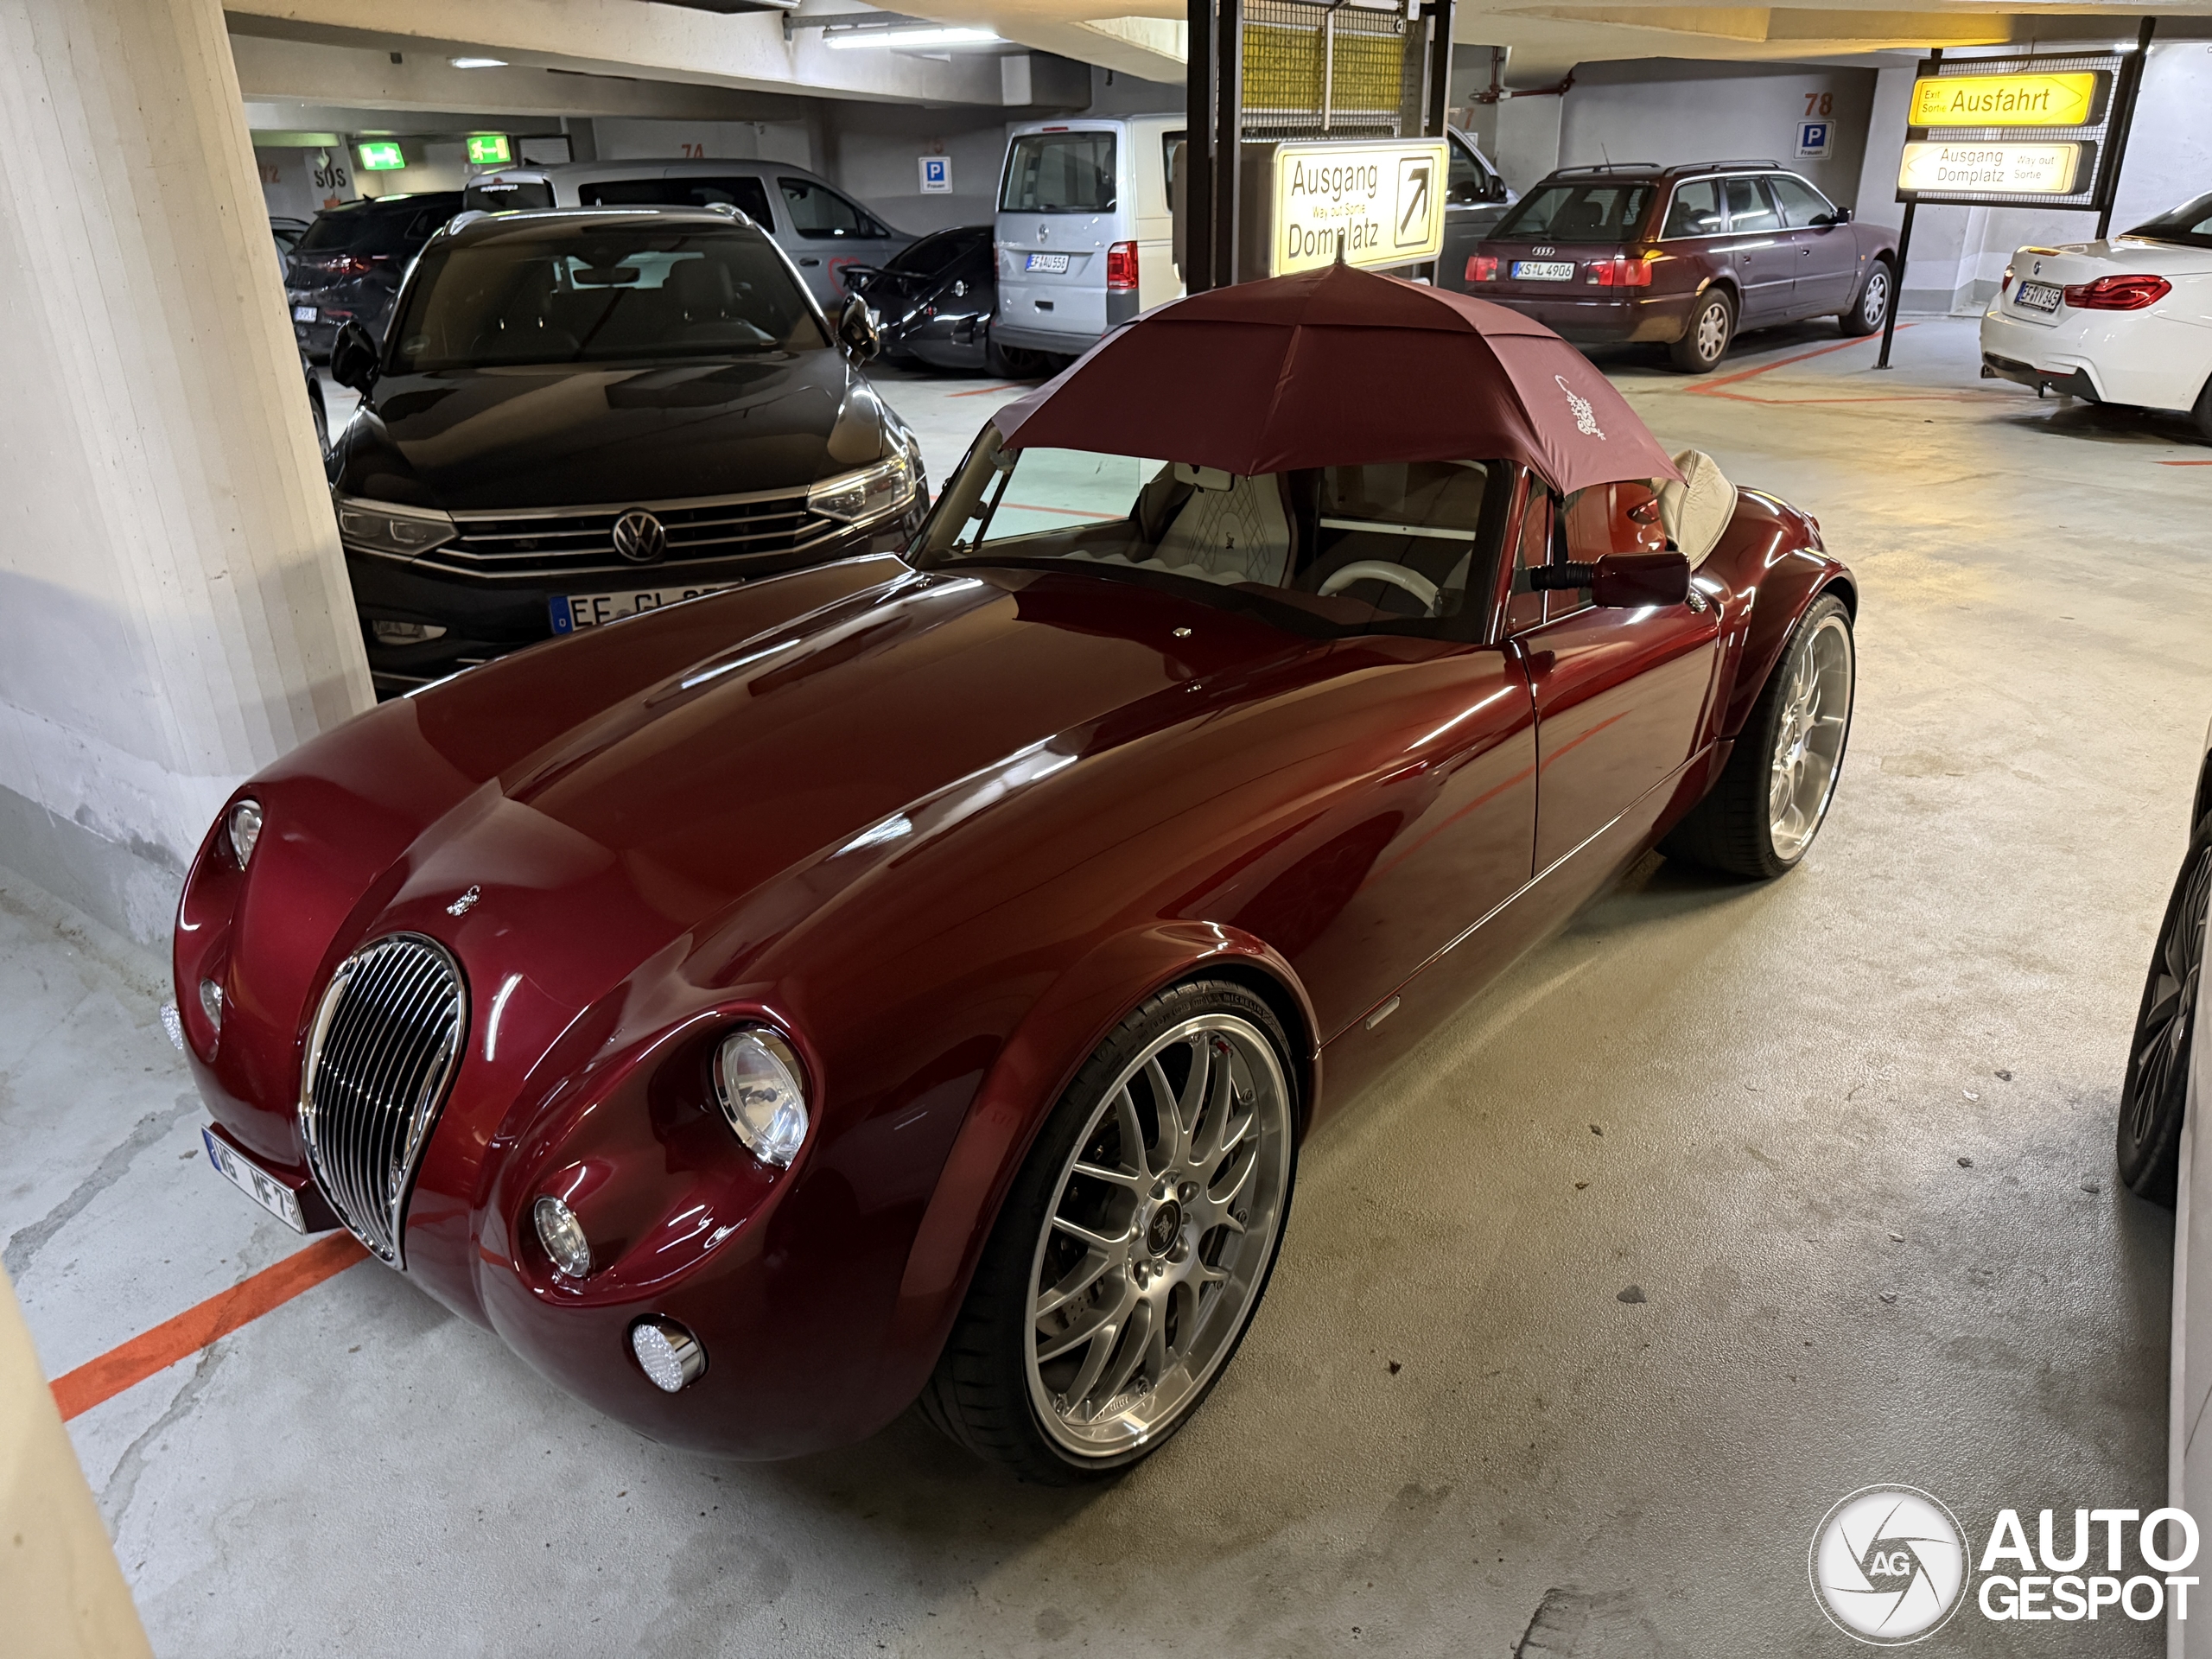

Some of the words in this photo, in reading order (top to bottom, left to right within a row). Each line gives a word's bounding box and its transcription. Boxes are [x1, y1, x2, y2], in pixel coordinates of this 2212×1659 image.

[1924, 90, 1940, 99] Exit
[1950, 88, 2050, 112] Ausfahrt
[1804, 92, 1833, 117] 78
[1922, 103, 1947, 113] Sortie
[1808, 127, 1822, 144] P
[1940, 148, 2004, 167] Ausgang
[2018, 156, 2037, 168] Way
[2039, 156, 2054, 165] out
[314, 168, 346, 188] SOS
[930, 163, 941, 179] P
[1937, 167, 2005, 185] Domplatz
[2014, 168, 2042, 179] Sortie
[1291, 160, 1378, 202] Ausgang
[1518, 263, 1532, 276] KS
[1546, 264, 1572, 276] 4906
[570, 597, 611, 627] EF
[273, 1185, 286, 1217] 7
